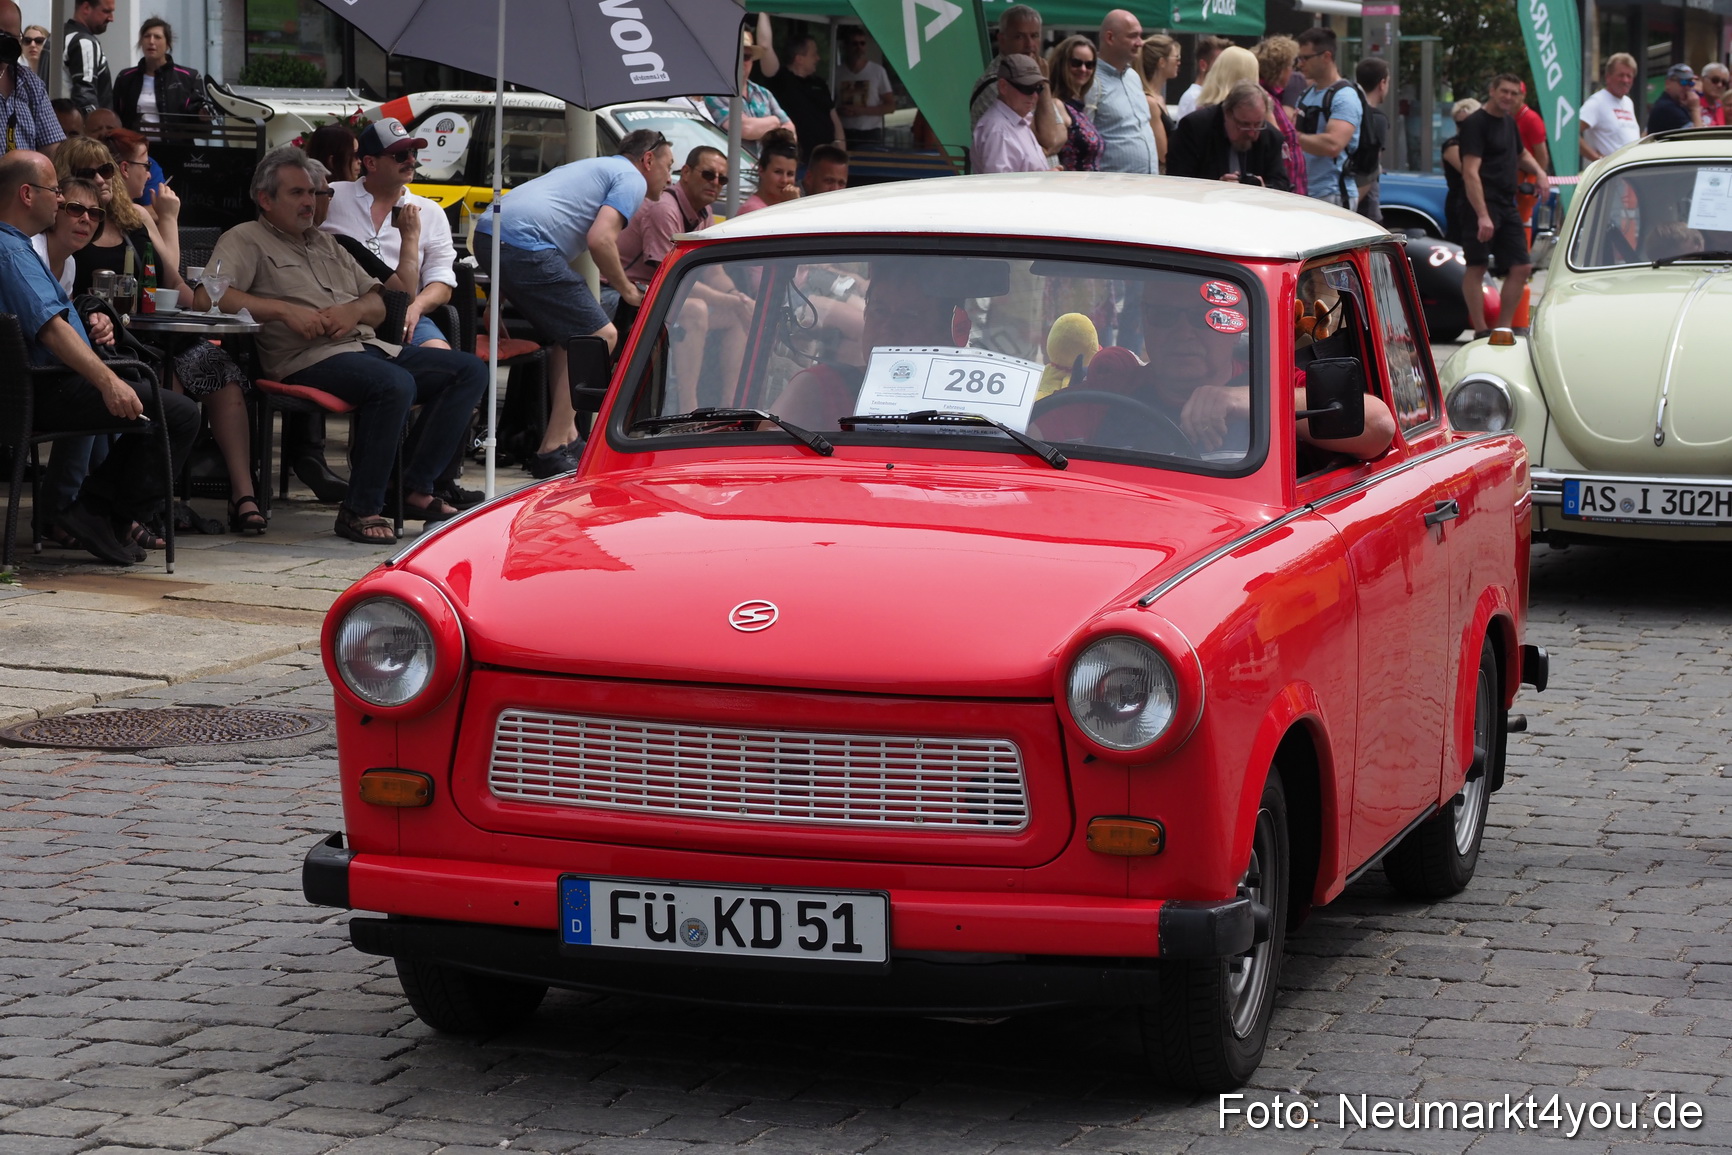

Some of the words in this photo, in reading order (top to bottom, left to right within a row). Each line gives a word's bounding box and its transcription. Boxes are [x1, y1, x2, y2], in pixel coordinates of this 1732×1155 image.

[437, 135, 447, 147] 6
[944, 369, 1006, 395] 286
[1568, 500, 1575, 509] D
[1581, 485, 1617, 512] AS
[1638, 488, 1652, 514] I
[572, 918, 582, 933] D
[609, 888, 677, 943] FÜ
[713, 895, 782, 949] KD
[797, 899, 863, 953] 51
